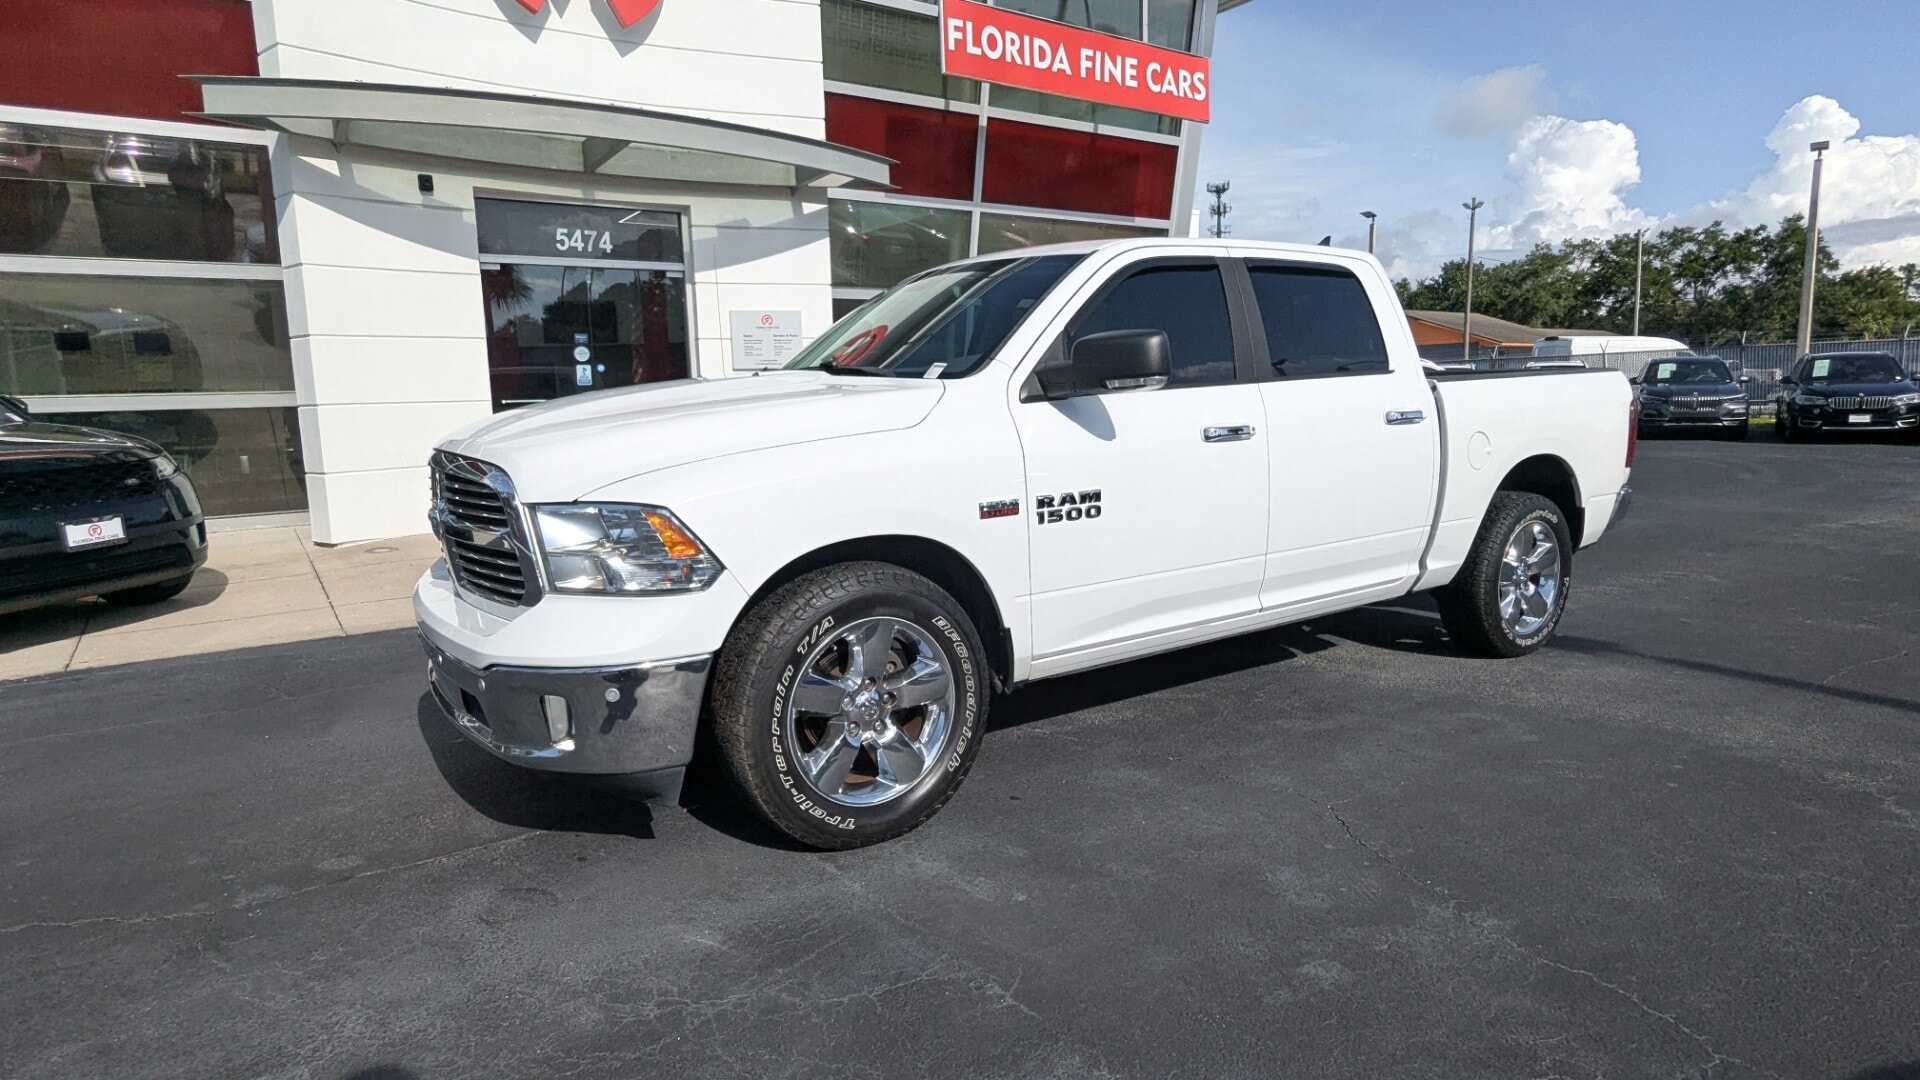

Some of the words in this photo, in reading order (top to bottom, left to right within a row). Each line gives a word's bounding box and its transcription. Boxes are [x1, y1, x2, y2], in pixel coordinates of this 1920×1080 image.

[947, 17, 1072, 76] FLORIDA
[1079, 47, 1138, 88] FINE
[1145, 62, 1207, 101] CARS
[555, 227, 614, 253] 5474
[979, 499, 1019, 511] HEMI
[1036, 489, 1102, 509] RAM
[1036, 504, 1102, 525] 1500
[72, 537, 94, 545] FLORIDA
[797, 615, 835, 655] T/A
[932, 615, 977, 773] BFGoodrich
[771, 664, 856, 830] Trail-Terrain
